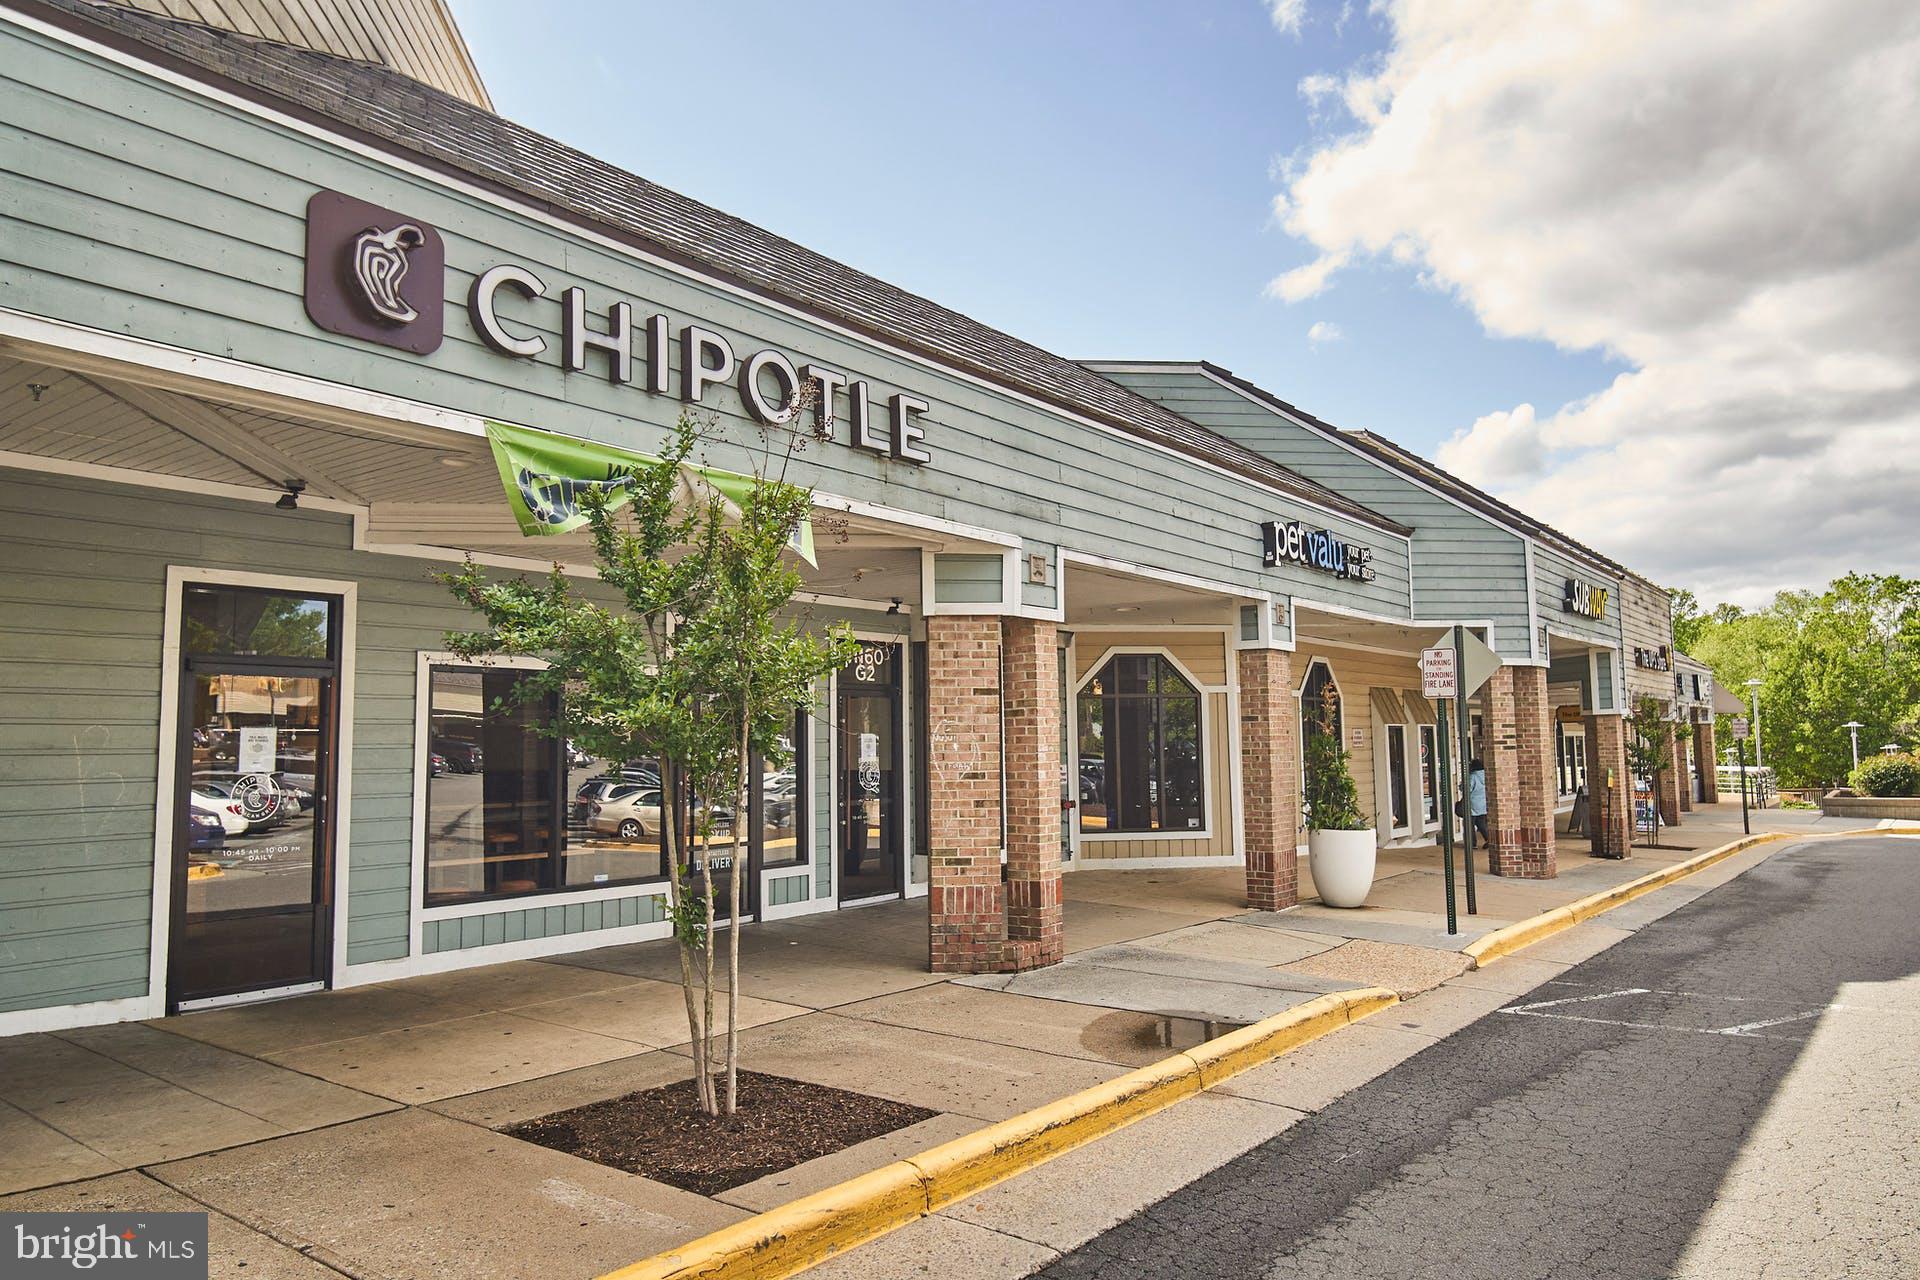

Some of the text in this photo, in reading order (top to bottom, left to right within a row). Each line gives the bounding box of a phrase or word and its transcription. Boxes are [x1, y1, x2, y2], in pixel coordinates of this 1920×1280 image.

[467, 263, 931, 464] CHIPOTLE
[1273, 521, 1344, 577] pet valu
[1569, 579, 1608, 620] SUBWAY
[1425, 659, 1452, 667] PARKING
[855, 664, 876, 681] G2
[1424, 671, 1454, 679] STANDING
[1424, 680, 1454, 688] FIRE LANE
[248, 854, 273, 862] DAILY
